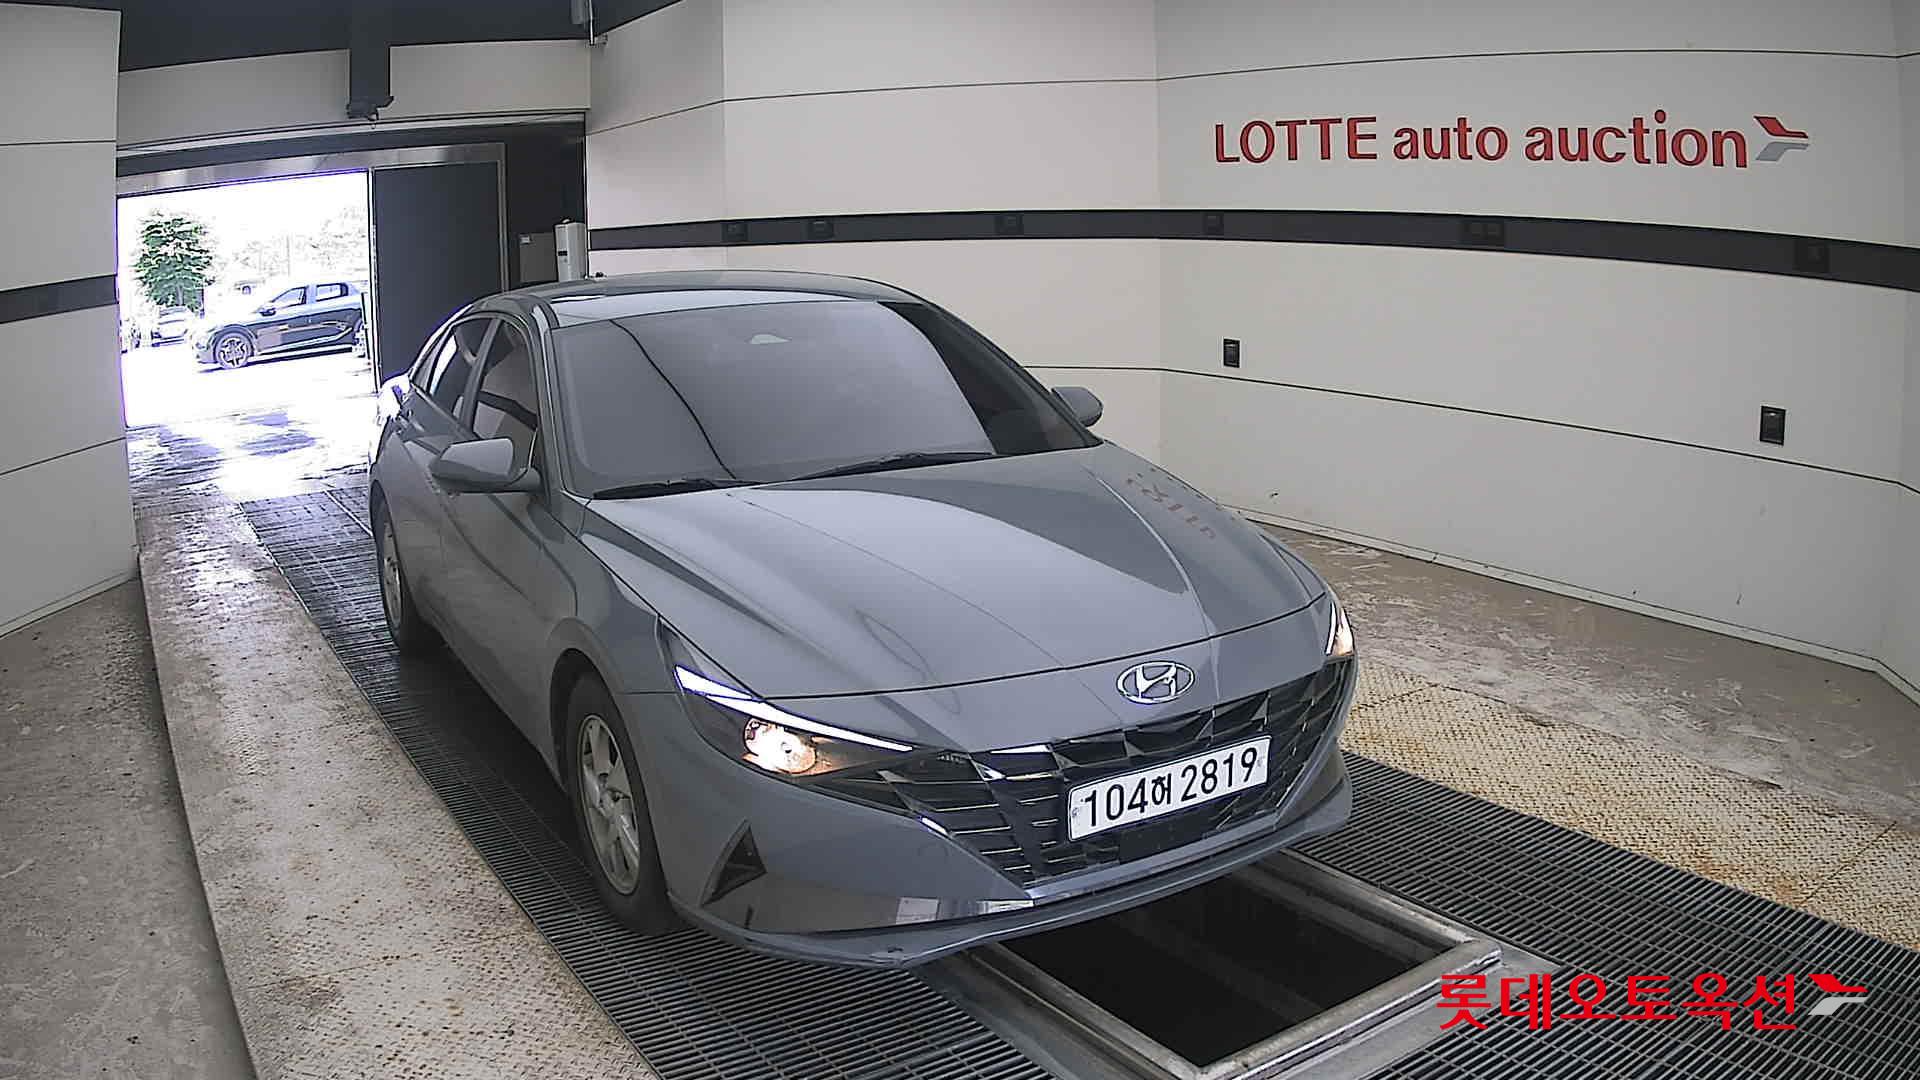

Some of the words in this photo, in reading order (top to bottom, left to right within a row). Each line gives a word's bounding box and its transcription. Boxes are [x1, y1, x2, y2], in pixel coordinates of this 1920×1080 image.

[1215, 116, 1377, 163] LOTTE
[1393, 117, 1509, 161] auto
[1524, 109, 1748, 168] auction
